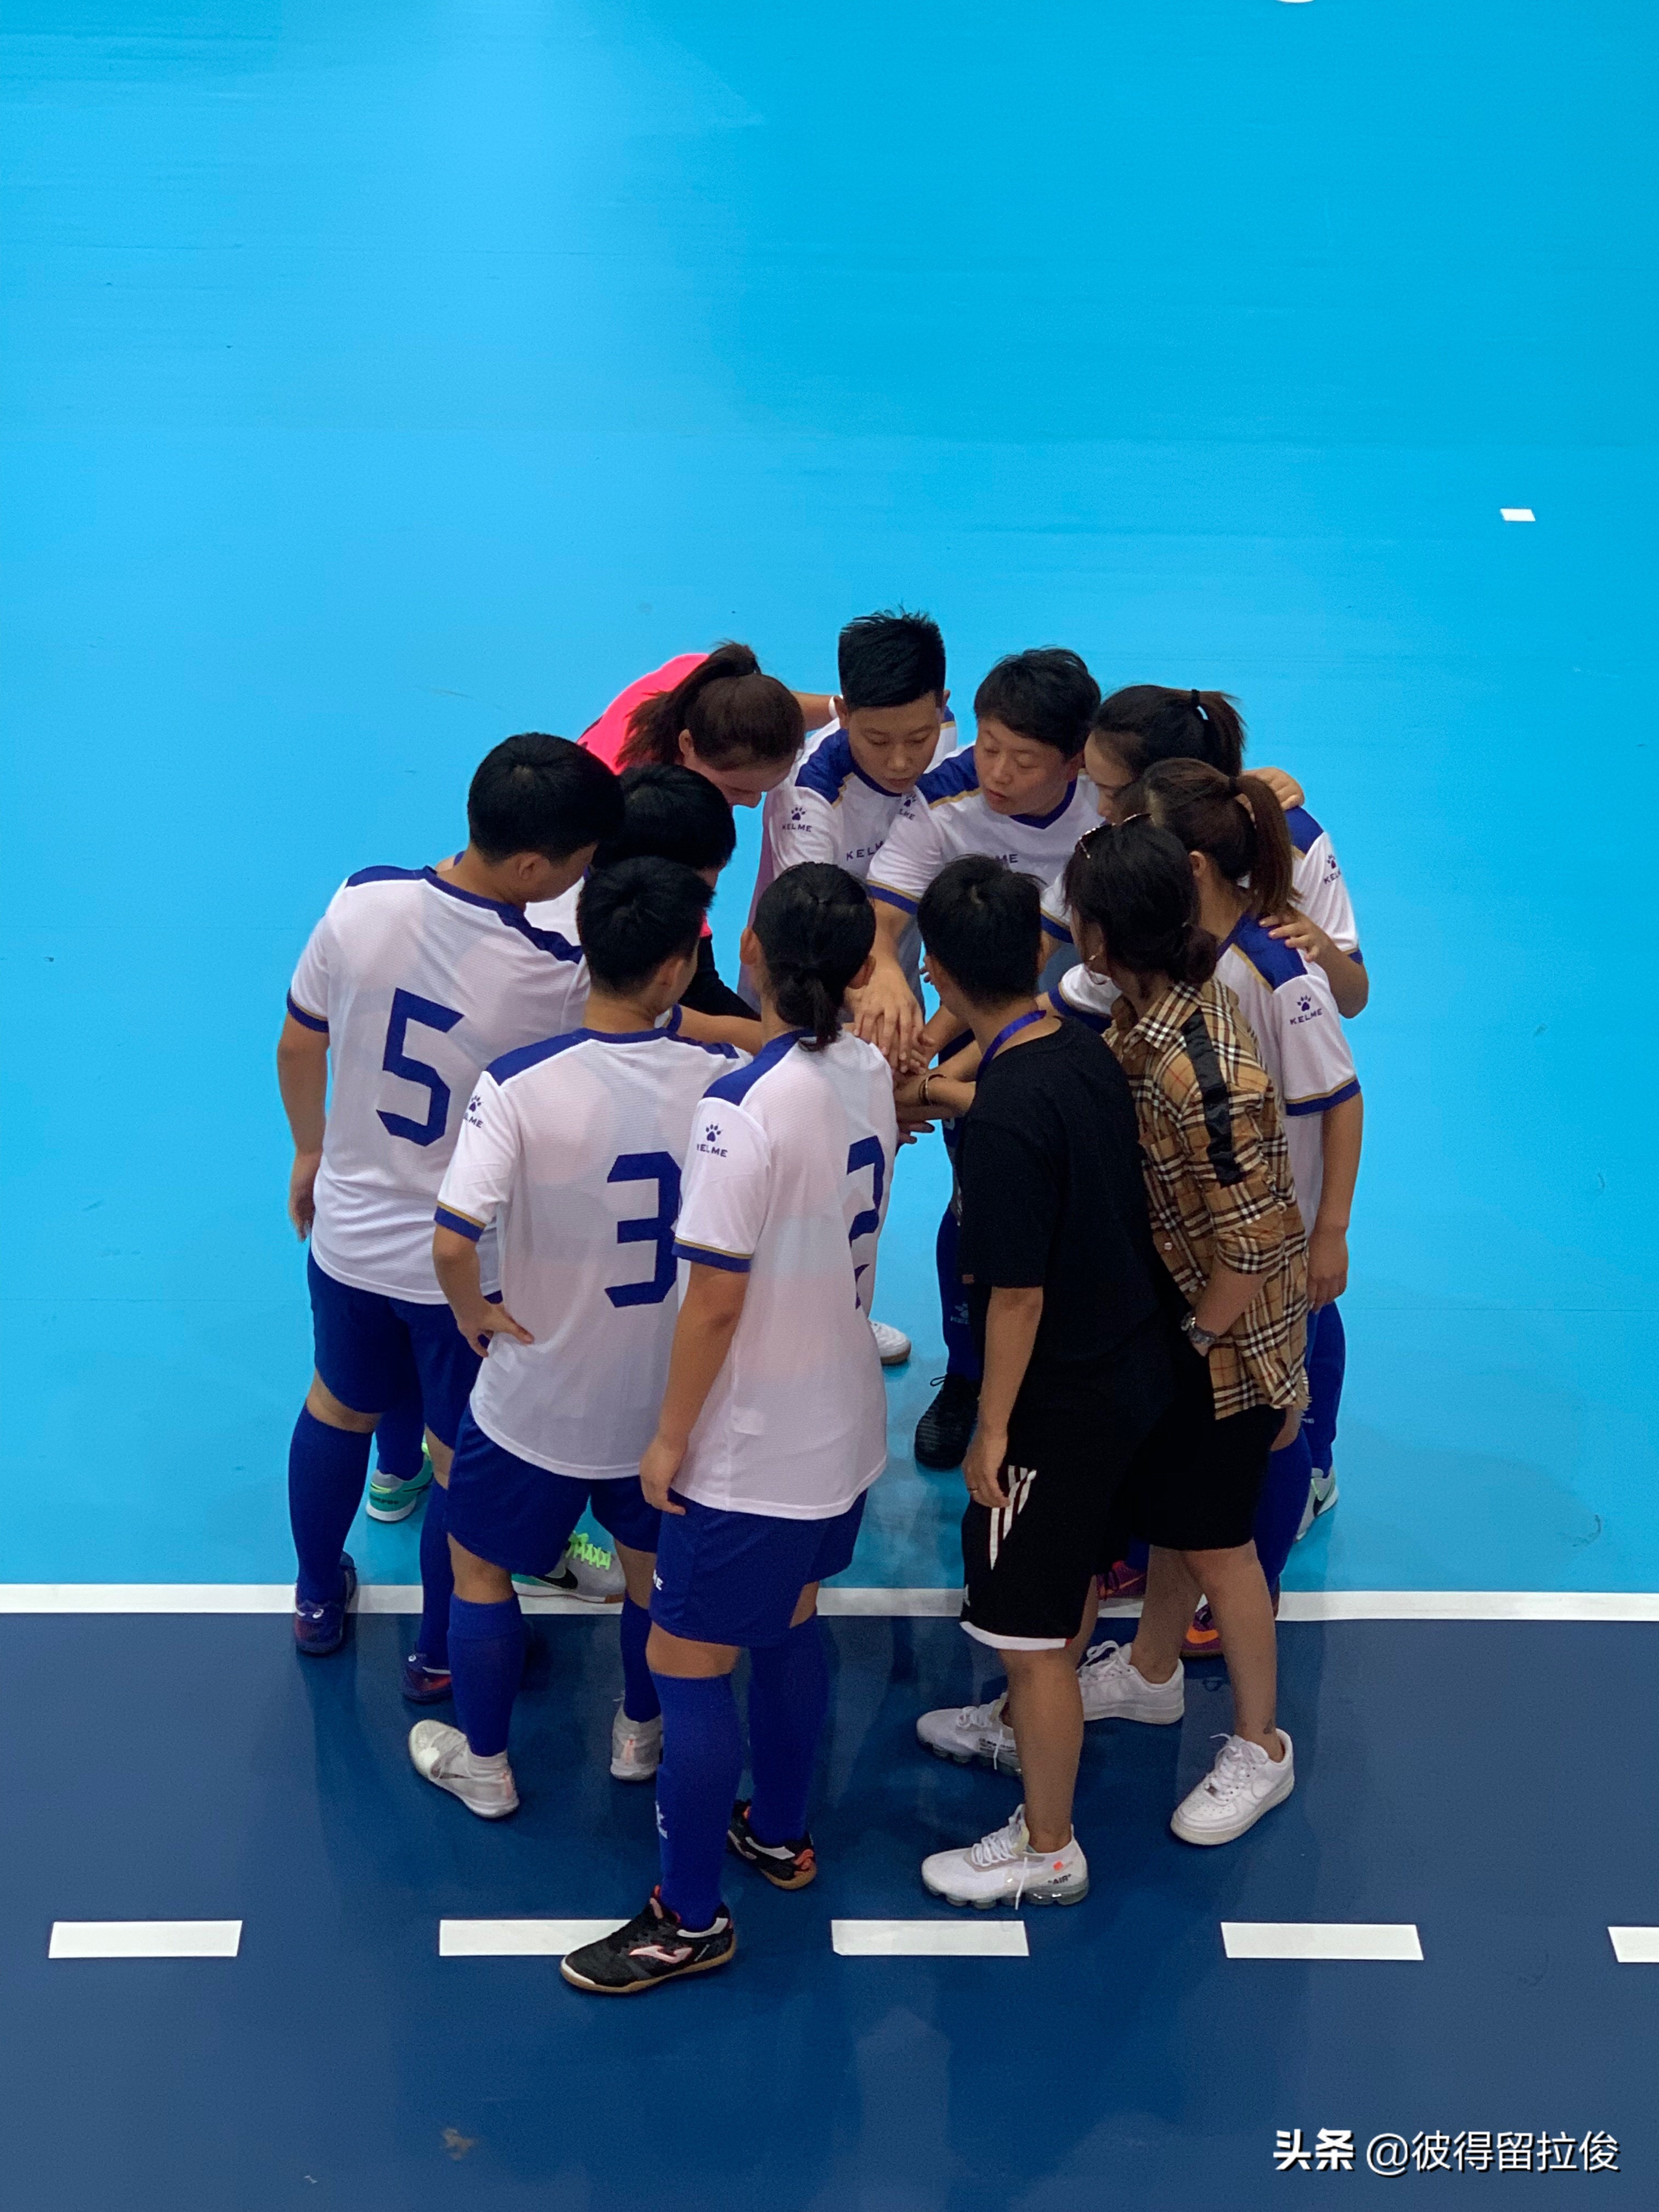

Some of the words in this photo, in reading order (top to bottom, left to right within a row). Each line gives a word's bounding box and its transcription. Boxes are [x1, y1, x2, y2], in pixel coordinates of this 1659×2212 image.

[782, 823, 812, 833] KELME
[845, 840, 884, 861] KELM
[1289, 1008, 1323, 1025] KELME
[376, 988, 465, 1147] 5
[605, 1151, 682, 1308] 3
